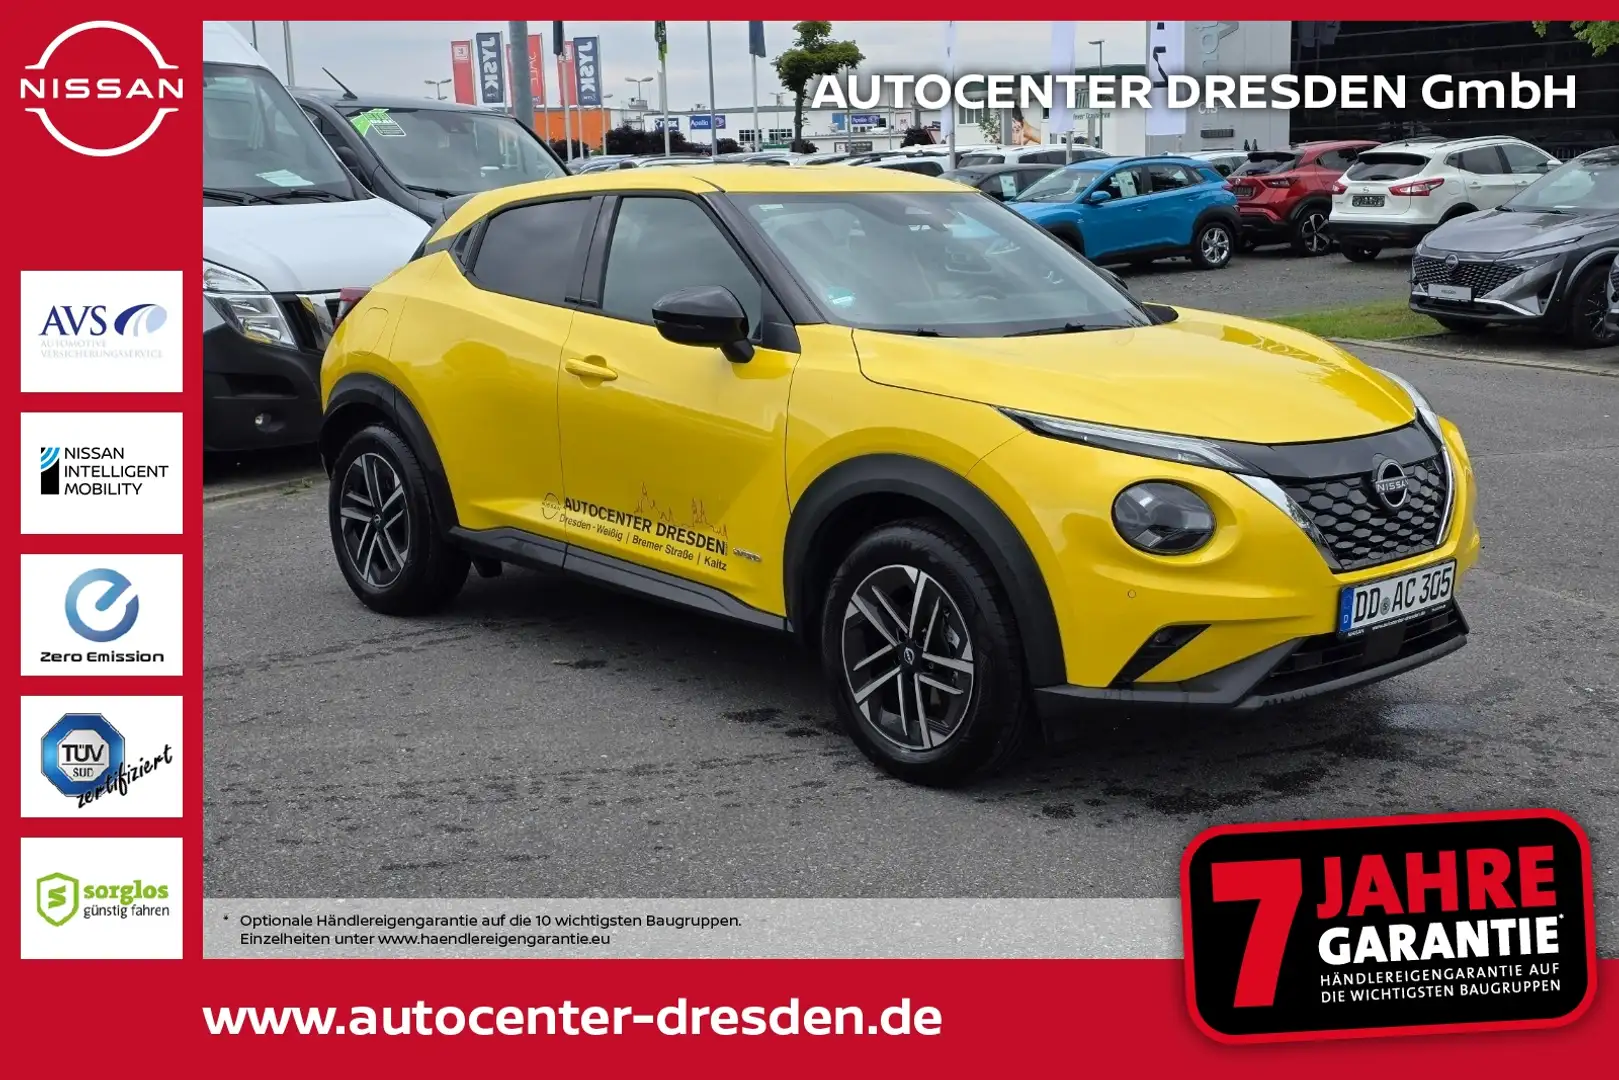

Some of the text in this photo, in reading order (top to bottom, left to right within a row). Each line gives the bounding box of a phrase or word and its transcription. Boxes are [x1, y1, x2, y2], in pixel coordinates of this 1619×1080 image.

[659, 120, 678, 128] JSK
[1377, 479, 1409, 493] NISSAN
[564, 497, 653, 534] AUTOCENTER
[656, 523, 726, 556] DRESDEN
[632, 535, 664, 552] Bremer
[665, 544, 694, 561] Straße
[704, 555, 727, 571] Kaitz
[1354, 567, 1452, 623] DD AC 305
